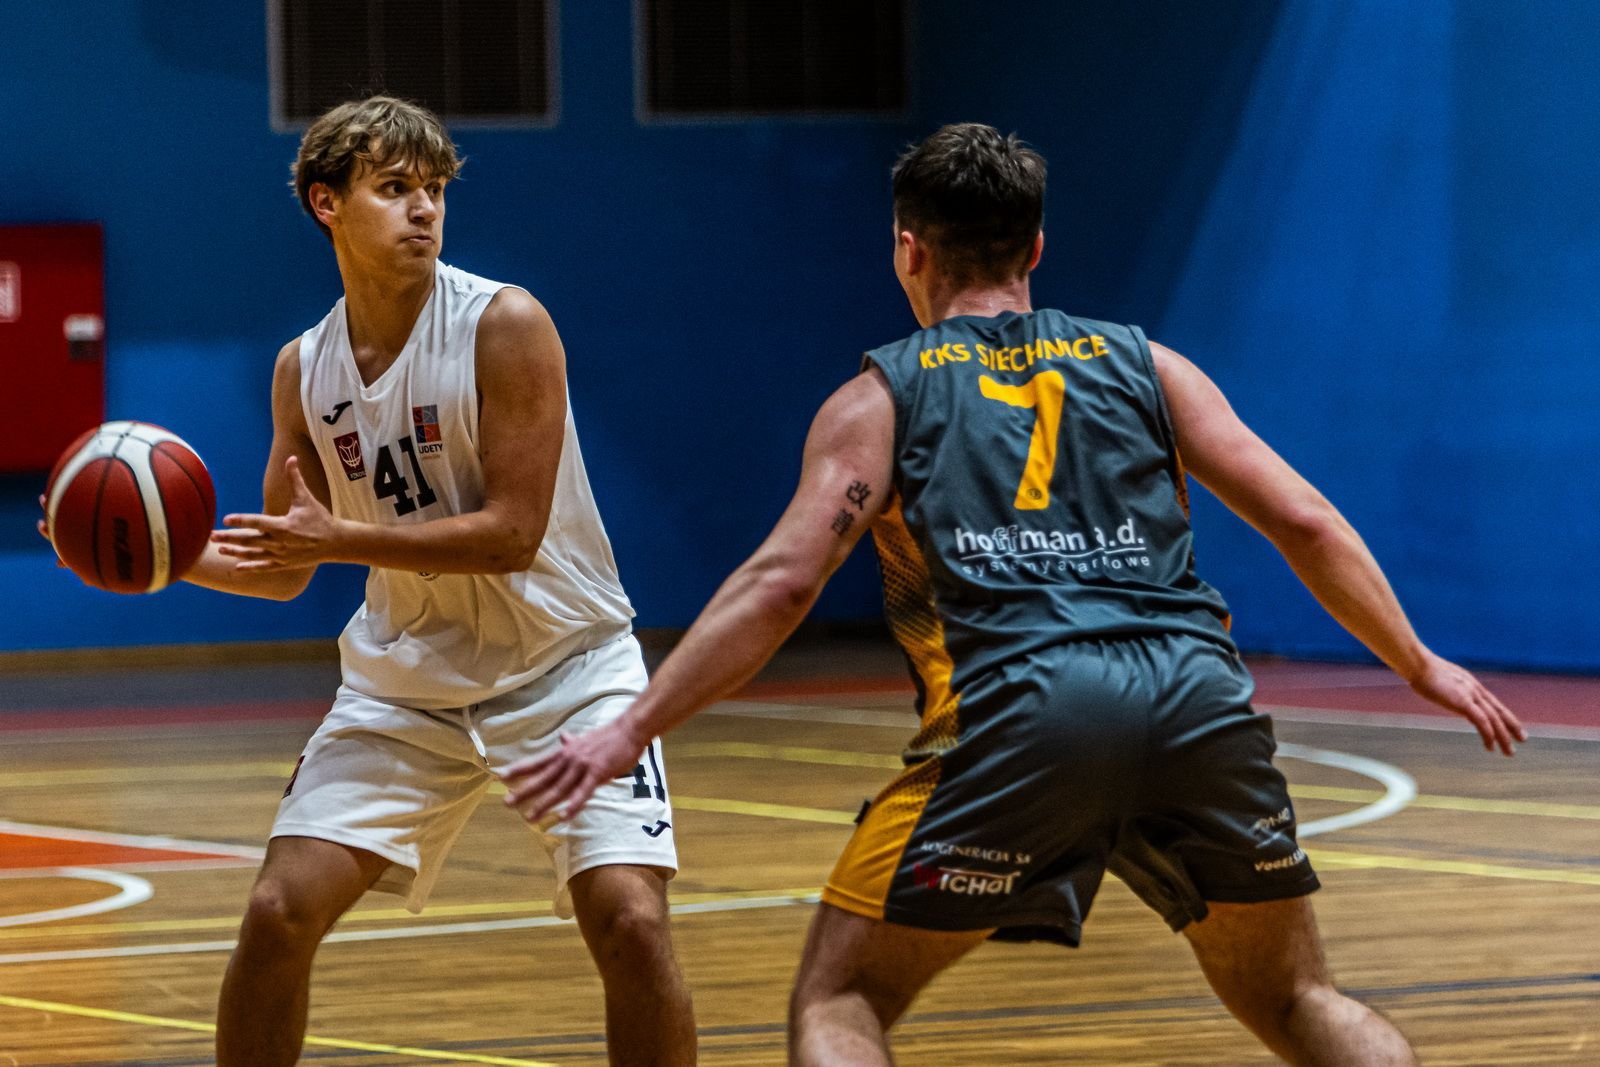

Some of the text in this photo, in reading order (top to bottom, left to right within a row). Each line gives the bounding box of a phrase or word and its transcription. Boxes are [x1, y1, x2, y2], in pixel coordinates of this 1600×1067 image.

[919, 335, 1110, 372] KKS SIECHNICE
[418, 443, 443, 454] UDETY
[978, 370, 1066, 510] 7
[373, 435, 437, 517] 41
[954, 525, 1086, 553] hoffman
